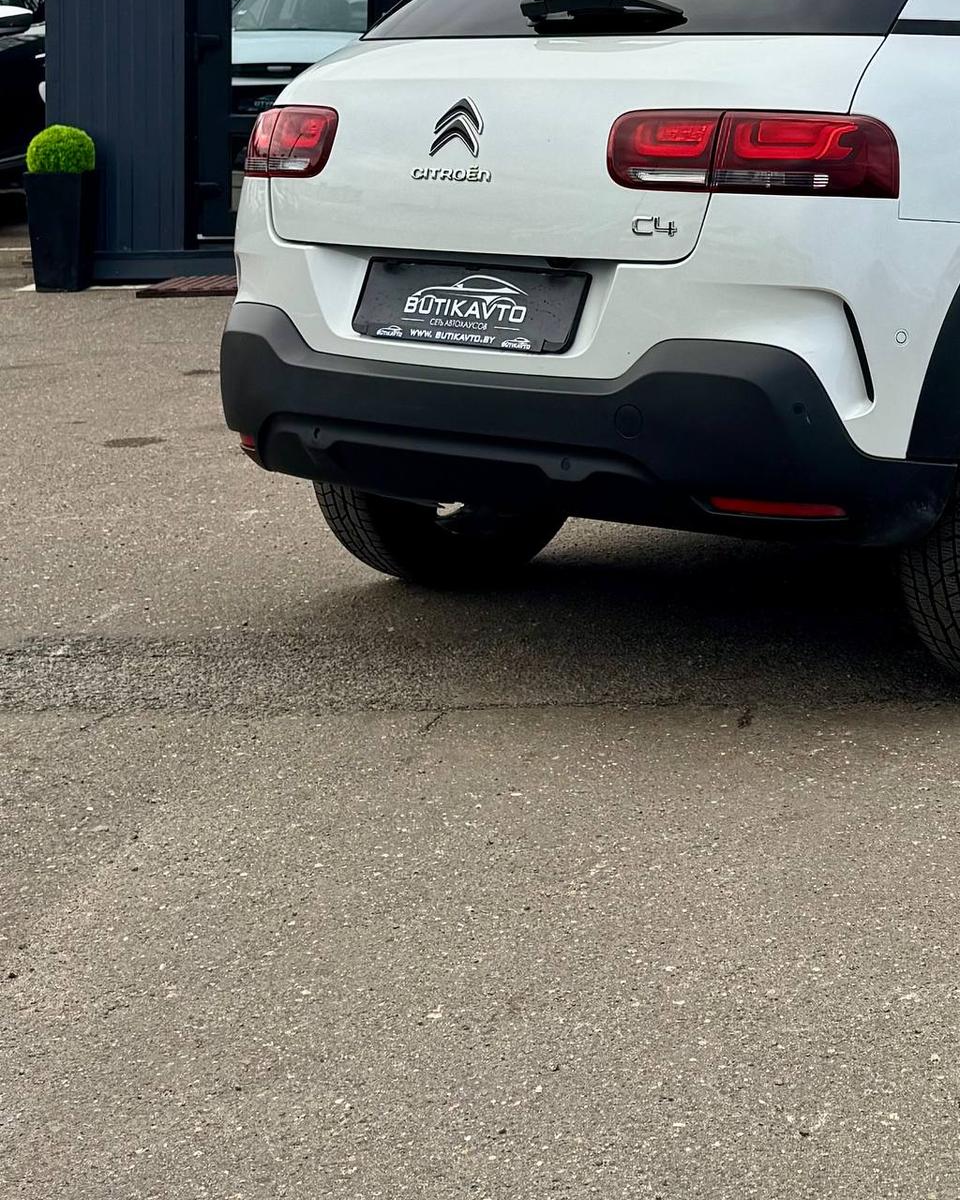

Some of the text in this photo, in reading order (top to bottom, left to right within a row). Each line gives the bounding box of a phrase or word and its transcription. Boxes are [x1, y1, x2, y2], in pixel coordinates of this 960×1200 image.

[632, 216, 678, 237] C4
[404, 296, 527, 323] BUTIKAVTO
[430, 318, 488, 330] СЕТЬ АВТОХАУСОВ
[435, 332, 495, 344] BUTIKAVTO.BY
